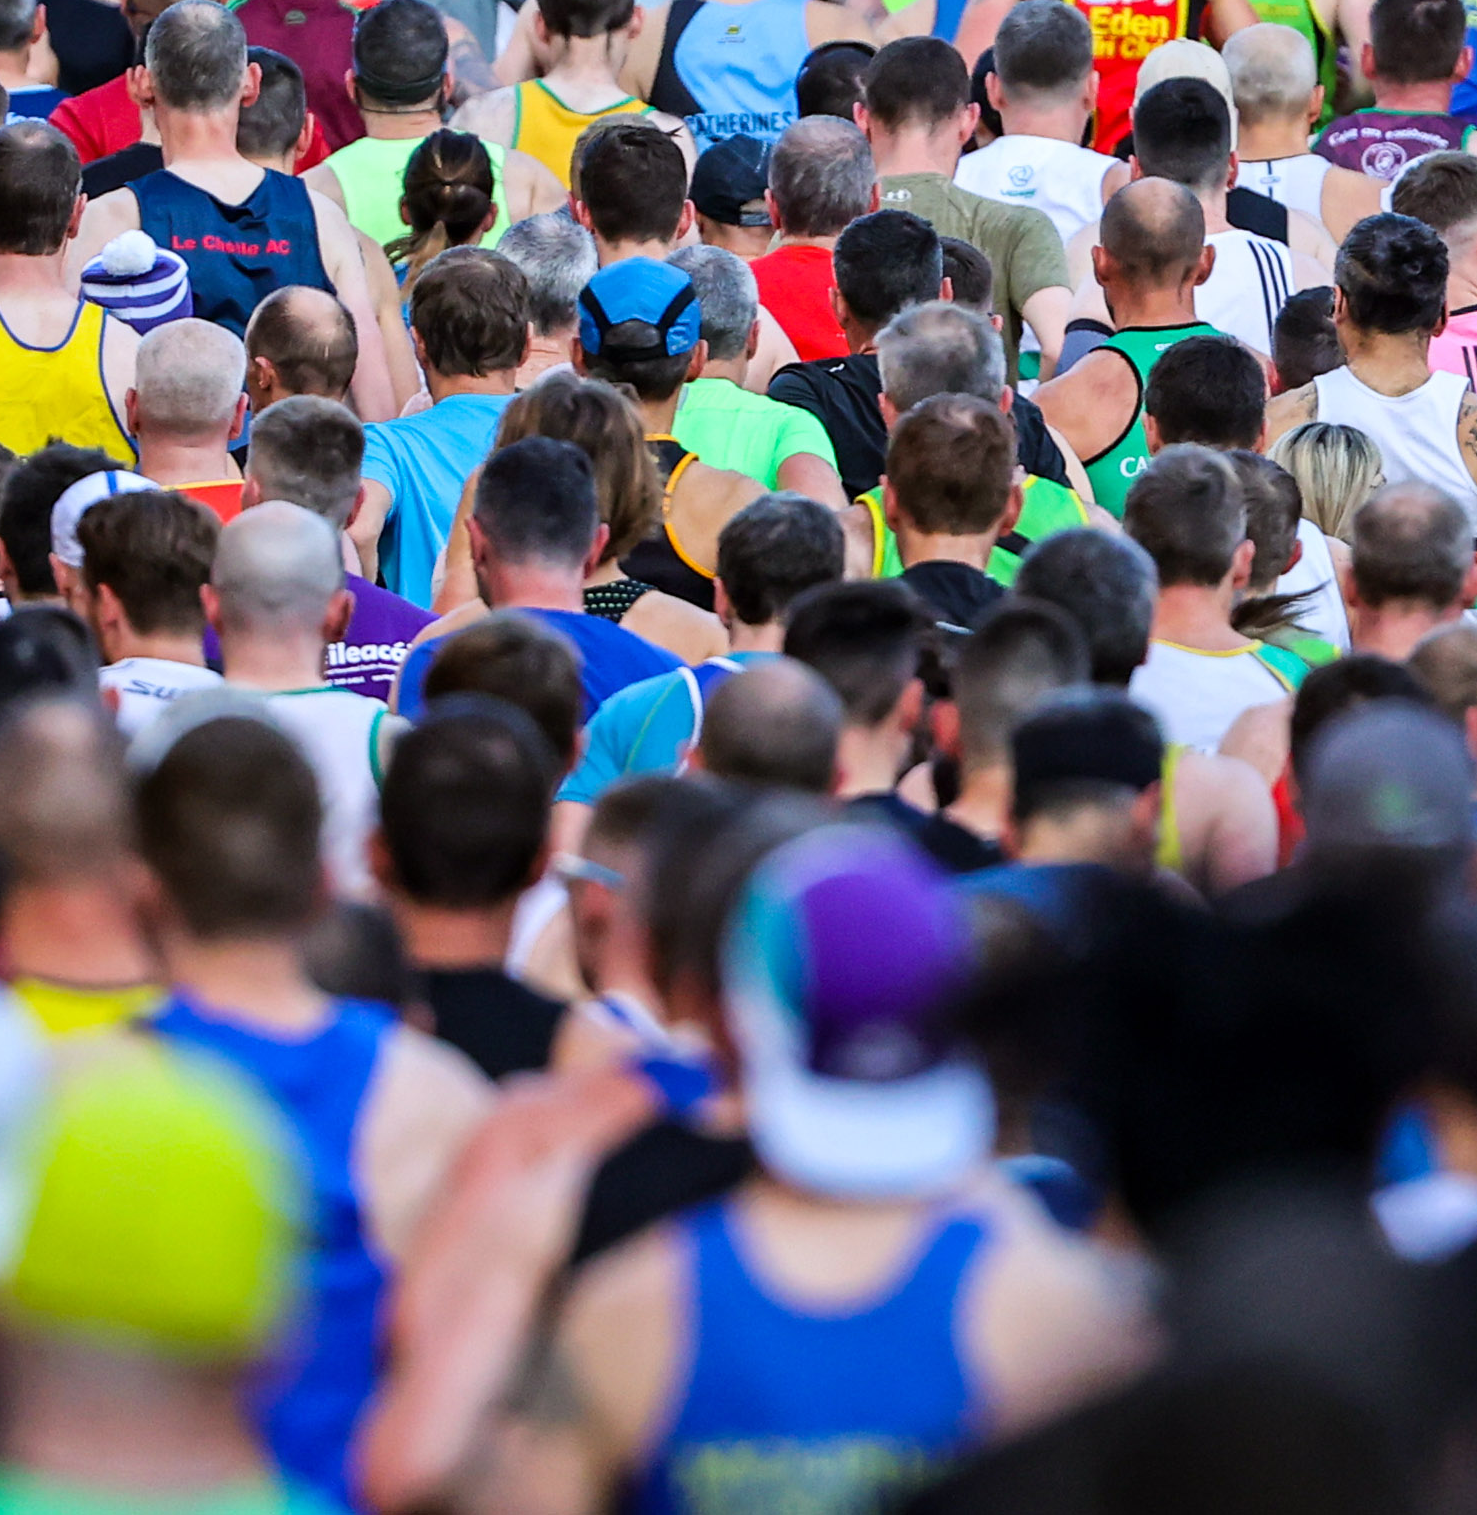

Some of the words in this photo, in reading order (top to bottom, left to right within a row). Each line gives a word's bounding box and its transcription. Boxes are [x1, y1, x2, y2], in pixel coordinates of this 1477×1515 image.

[1090, 6, 1171, 37] Eden
[171, 235, 197, 251] Le
[265, 239, 291, 256] AC
